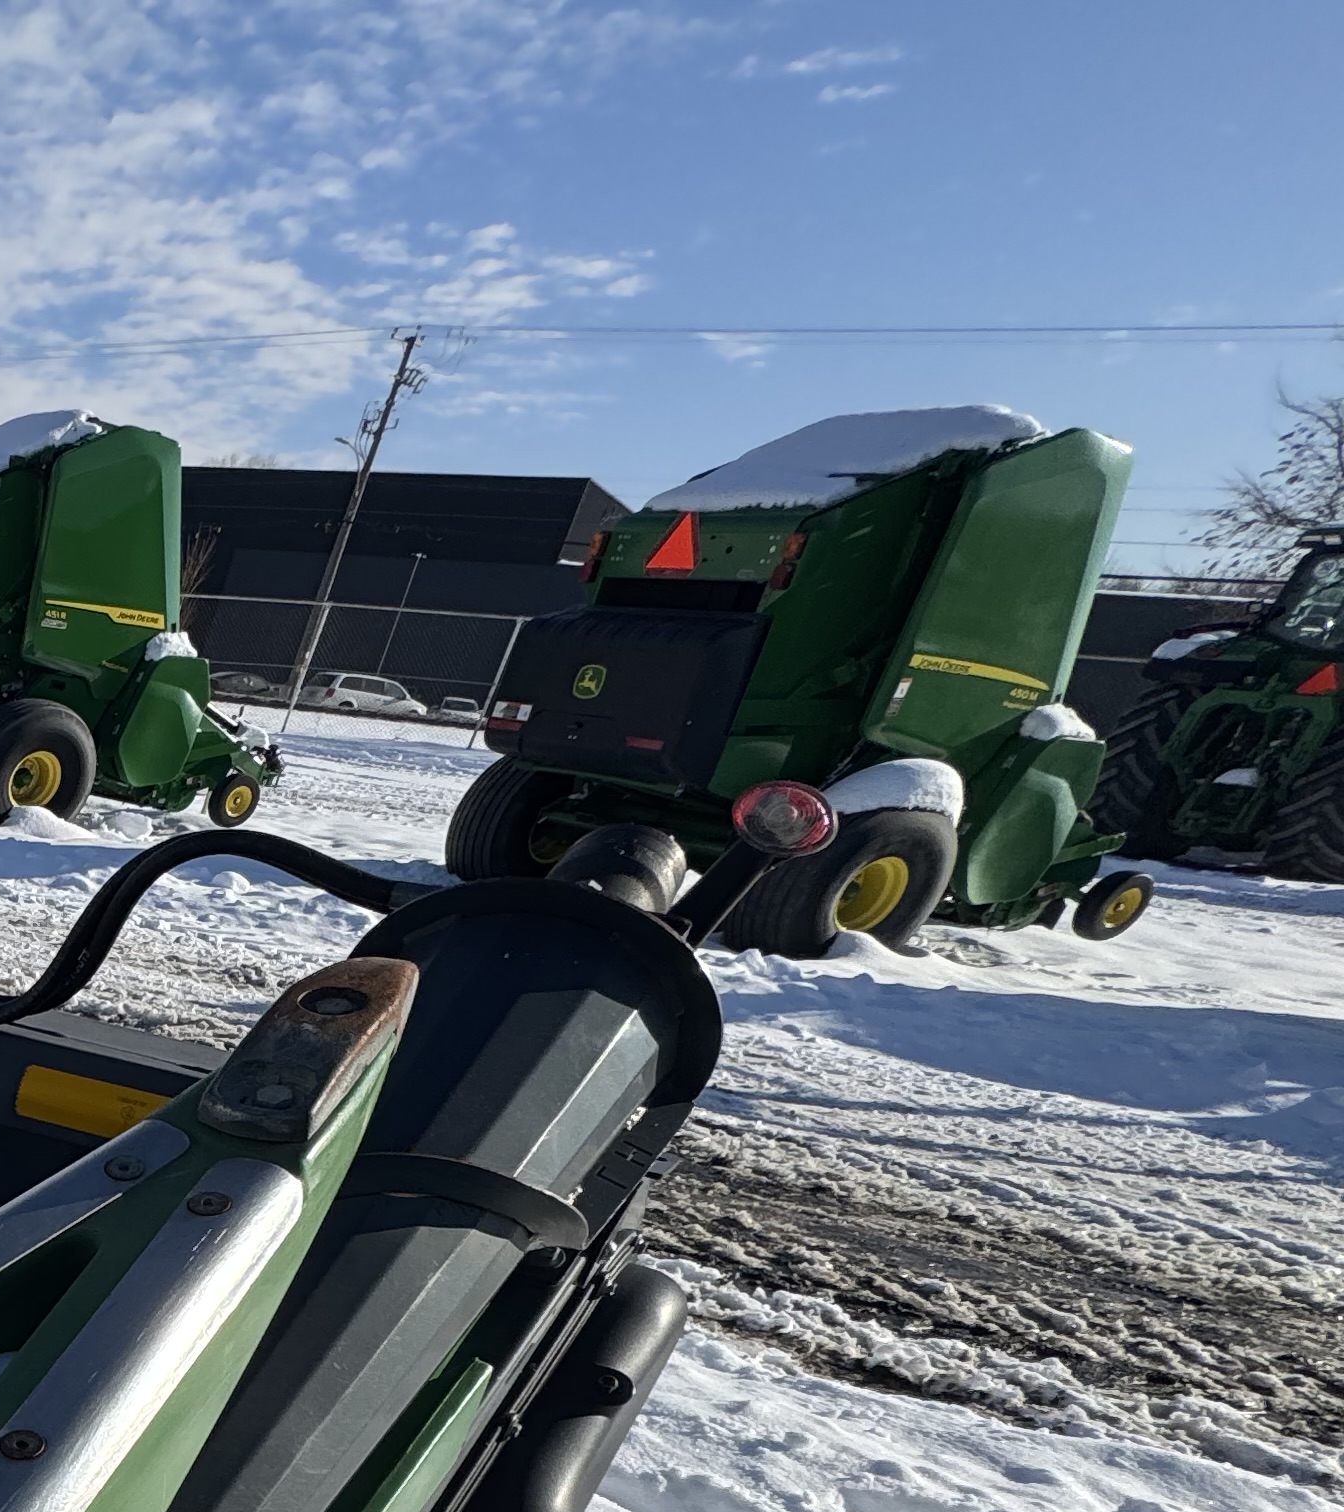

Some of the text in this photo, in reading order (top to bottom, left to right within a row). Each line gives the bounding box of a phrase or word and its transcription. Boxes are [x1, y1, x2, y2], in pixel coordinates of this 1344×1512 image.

[116, 611, 159, 624] JOHN DEERE
[918, 658, 971, 673] JOHN DEERE
